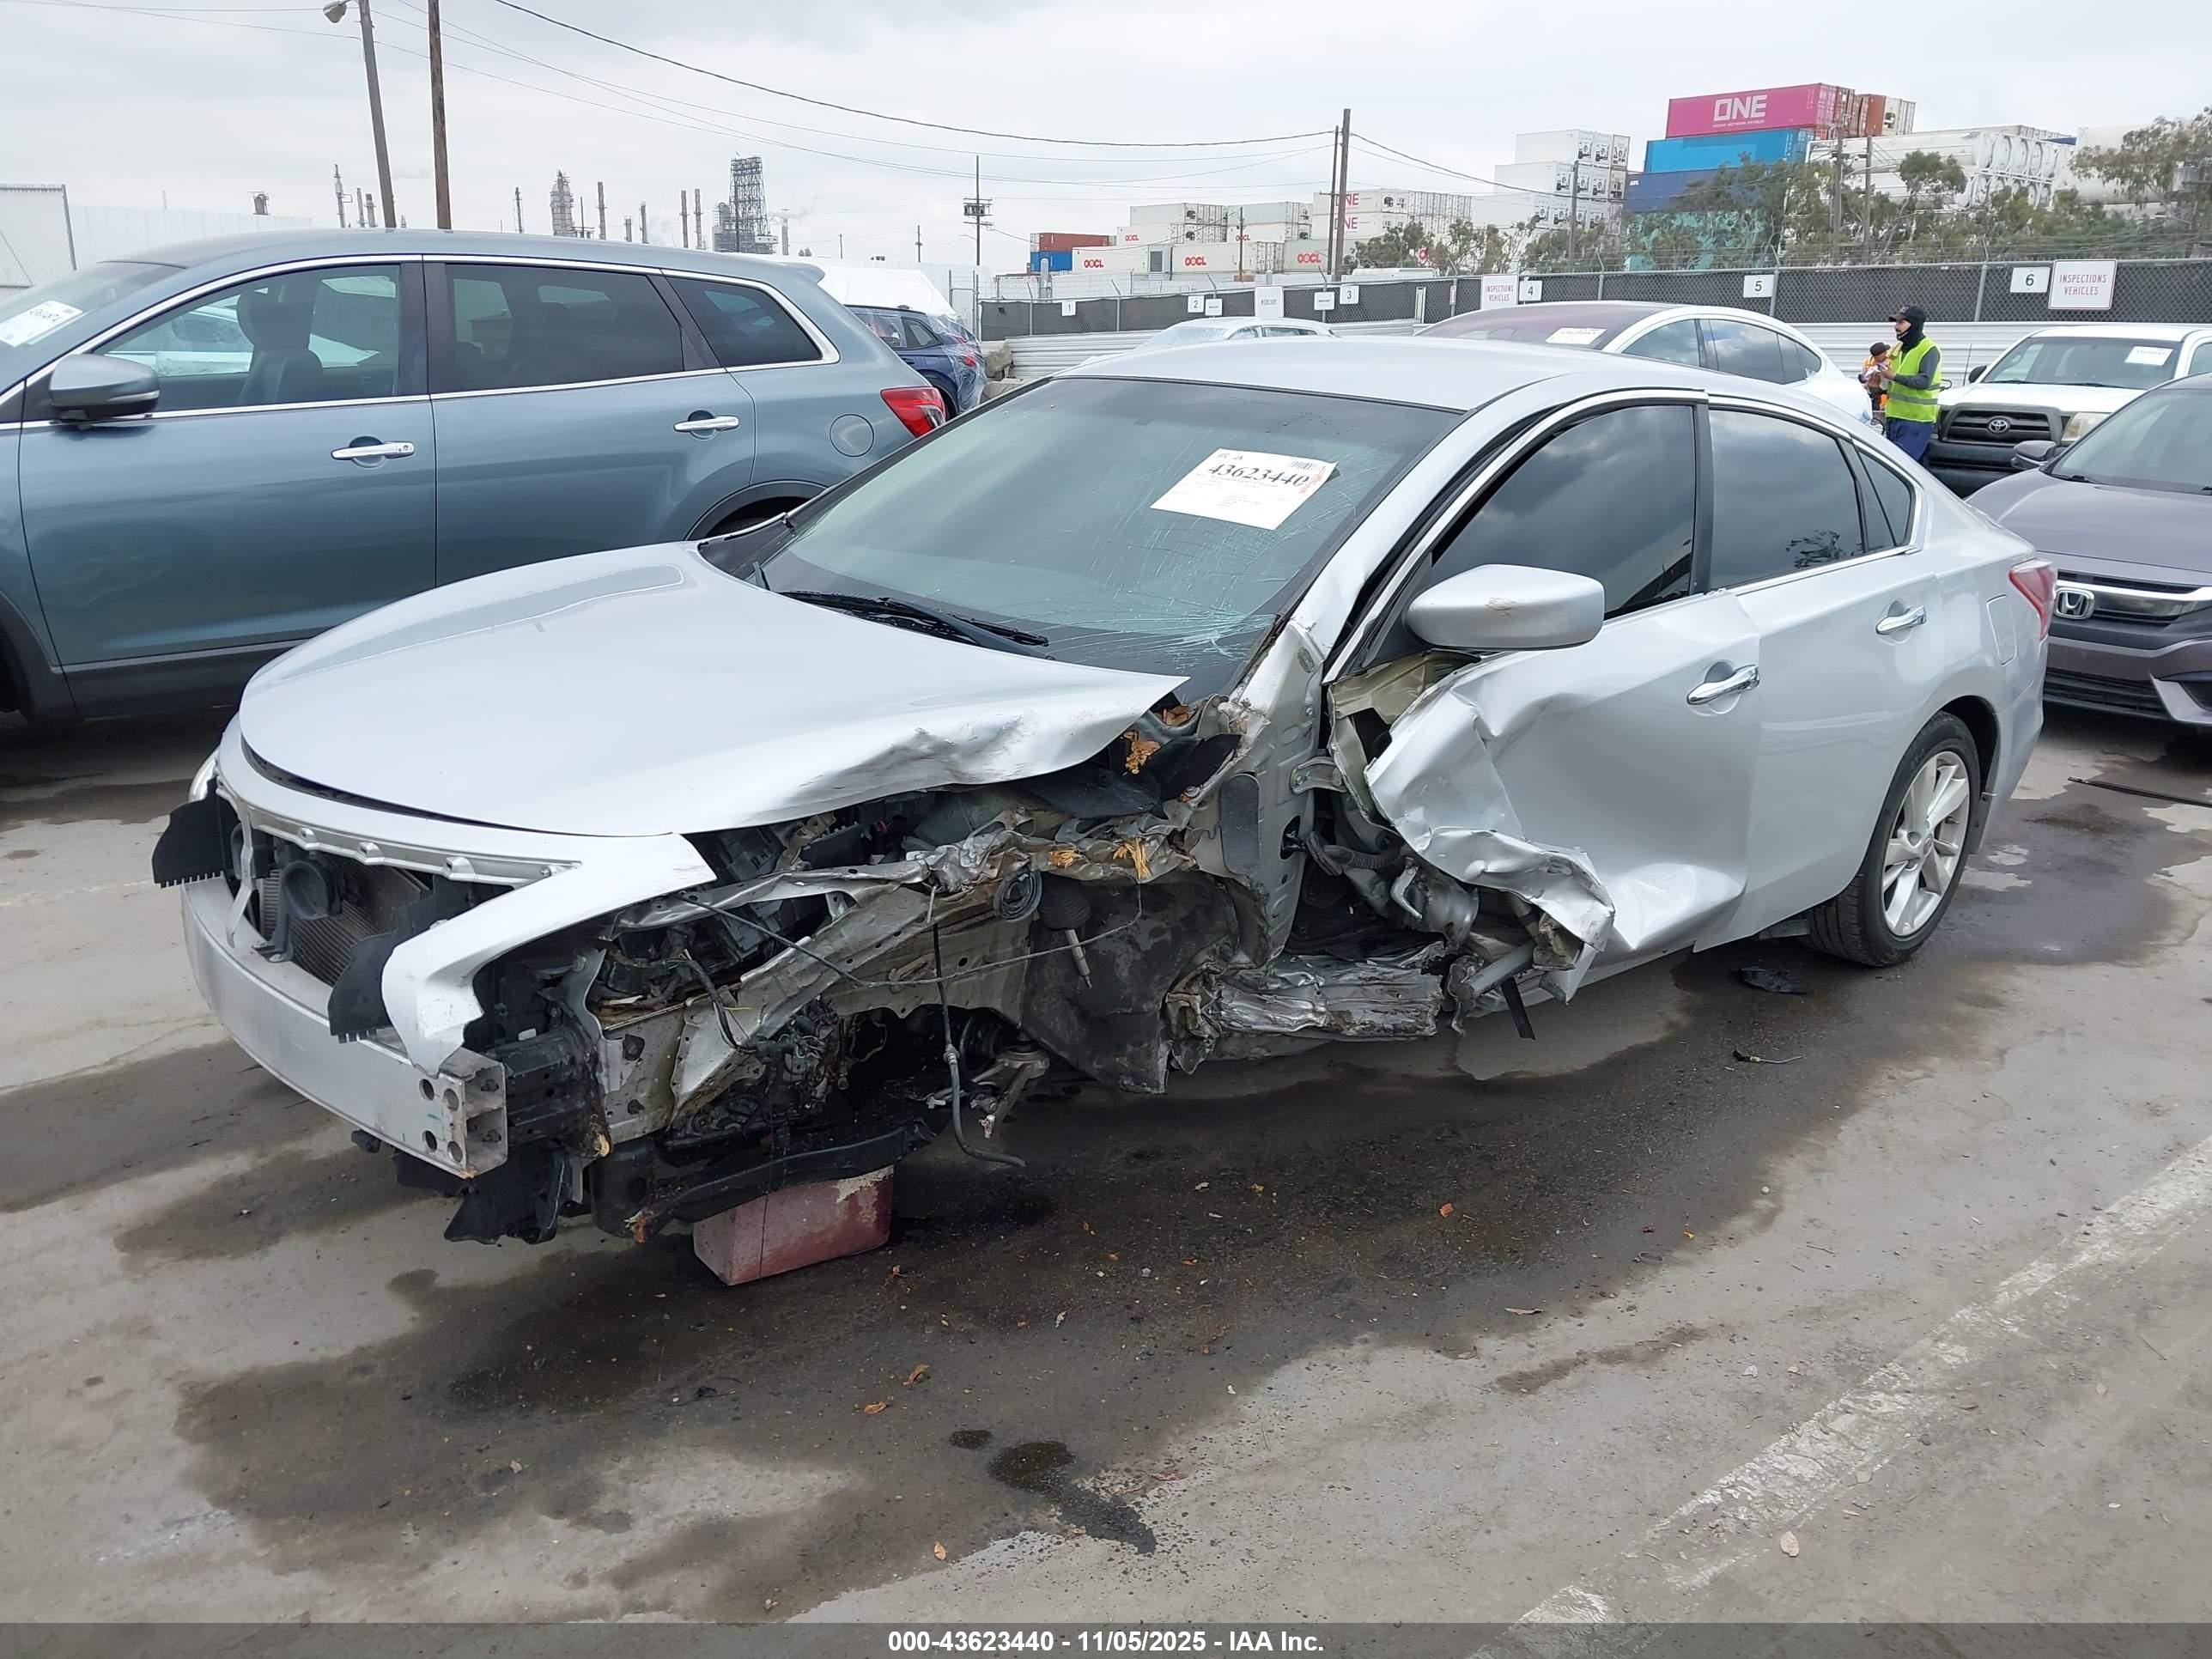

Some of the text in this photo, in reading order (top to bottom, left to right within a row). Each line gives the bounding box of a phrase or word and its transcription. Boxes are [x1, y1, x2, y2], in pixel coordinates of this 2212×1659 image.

[1713, 94, 1768, 121] ONE
[1084, 258, 1104, 268] OOCL
[1184, 257, 1206, 266] OOCL
[1297, 253, 1322, 264] OOCL
[2025, 273, 2035, 287] 6
[2058, 274, 2108, 283] INSPECTIONS
[1528, 285, 1534, 296] 4
[1754, 280, 1763, 292] 5
[2064, 286, 2100, 295] VEHICLES
[1346, 290, 1352, 300] 3
[1194, 300, 1199, 309] 2
